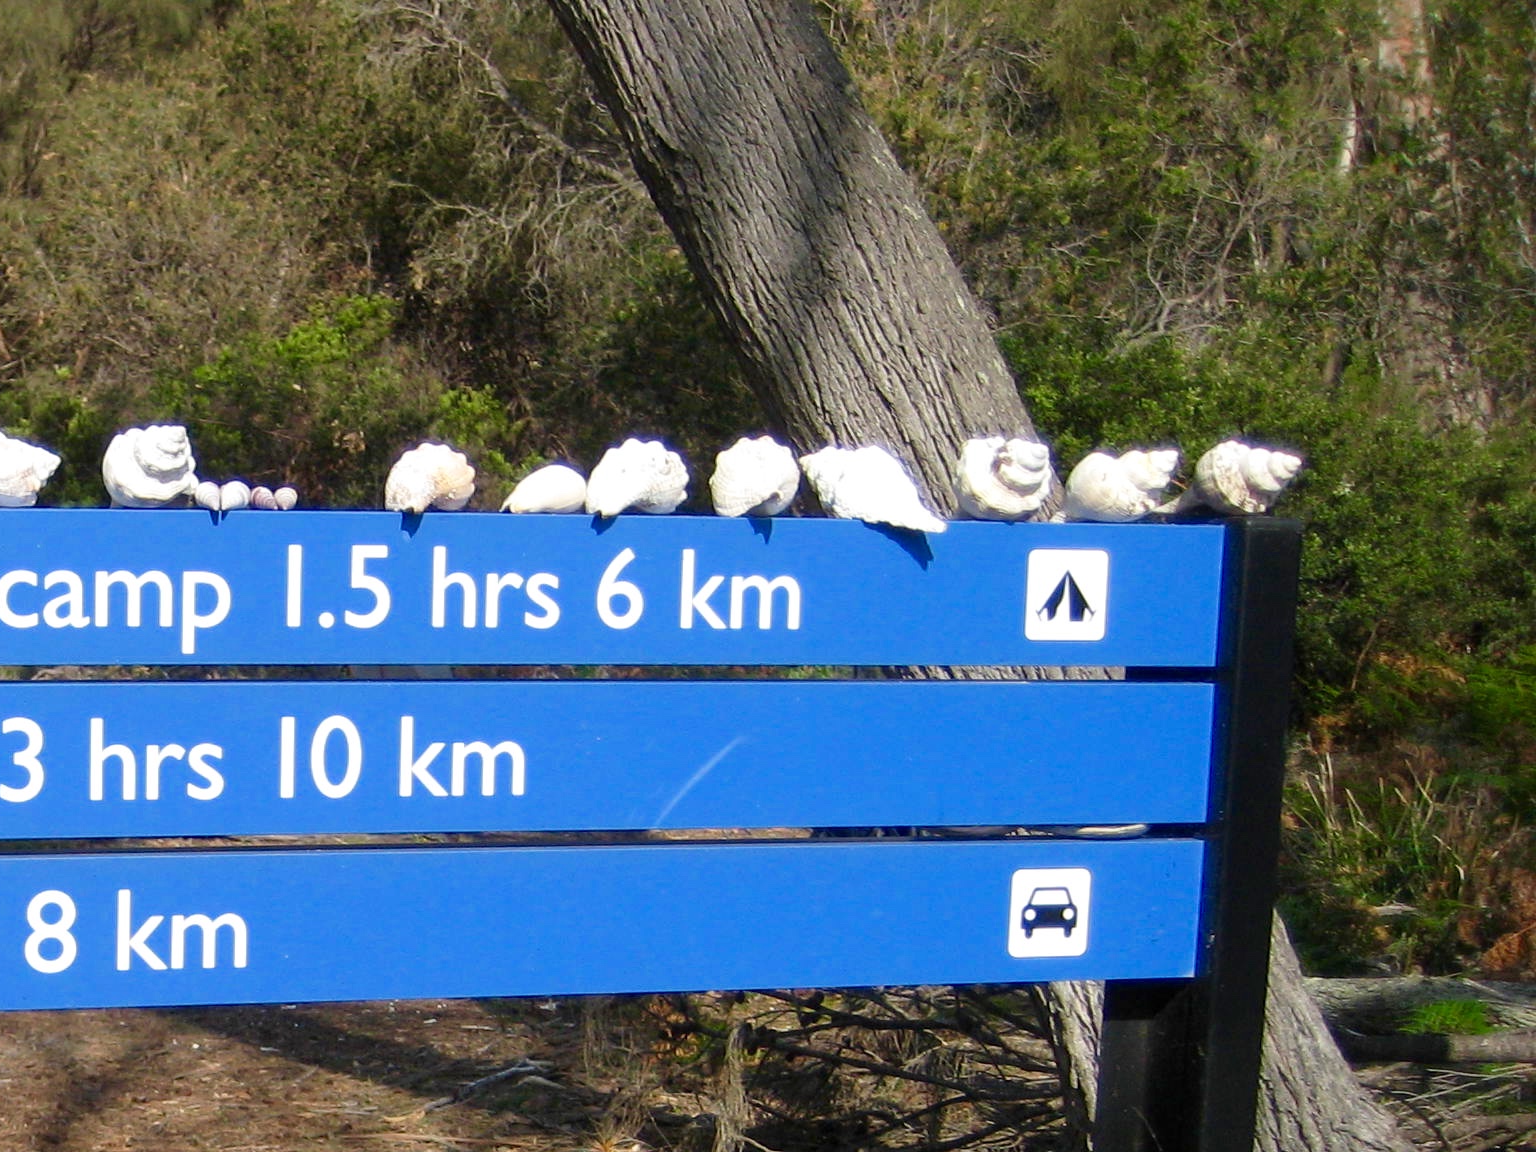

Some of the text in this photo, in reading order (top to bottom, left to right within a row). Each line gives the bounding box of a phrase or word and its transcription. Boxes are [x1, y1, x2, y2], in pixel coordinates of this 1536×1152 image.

[285, 543, 392, 630] 1.5
[430, 544, 561, 630] hrs
[595, 547, 645, 630] 6
[678, 547, 803, 631] km
[88, 717, 225, 802] hrs
[279, 714, 363, 800] 10
[398, 714, 527, 798] km
[23, 889, 78, 975] 8
[115, 888, 249, 972] km
